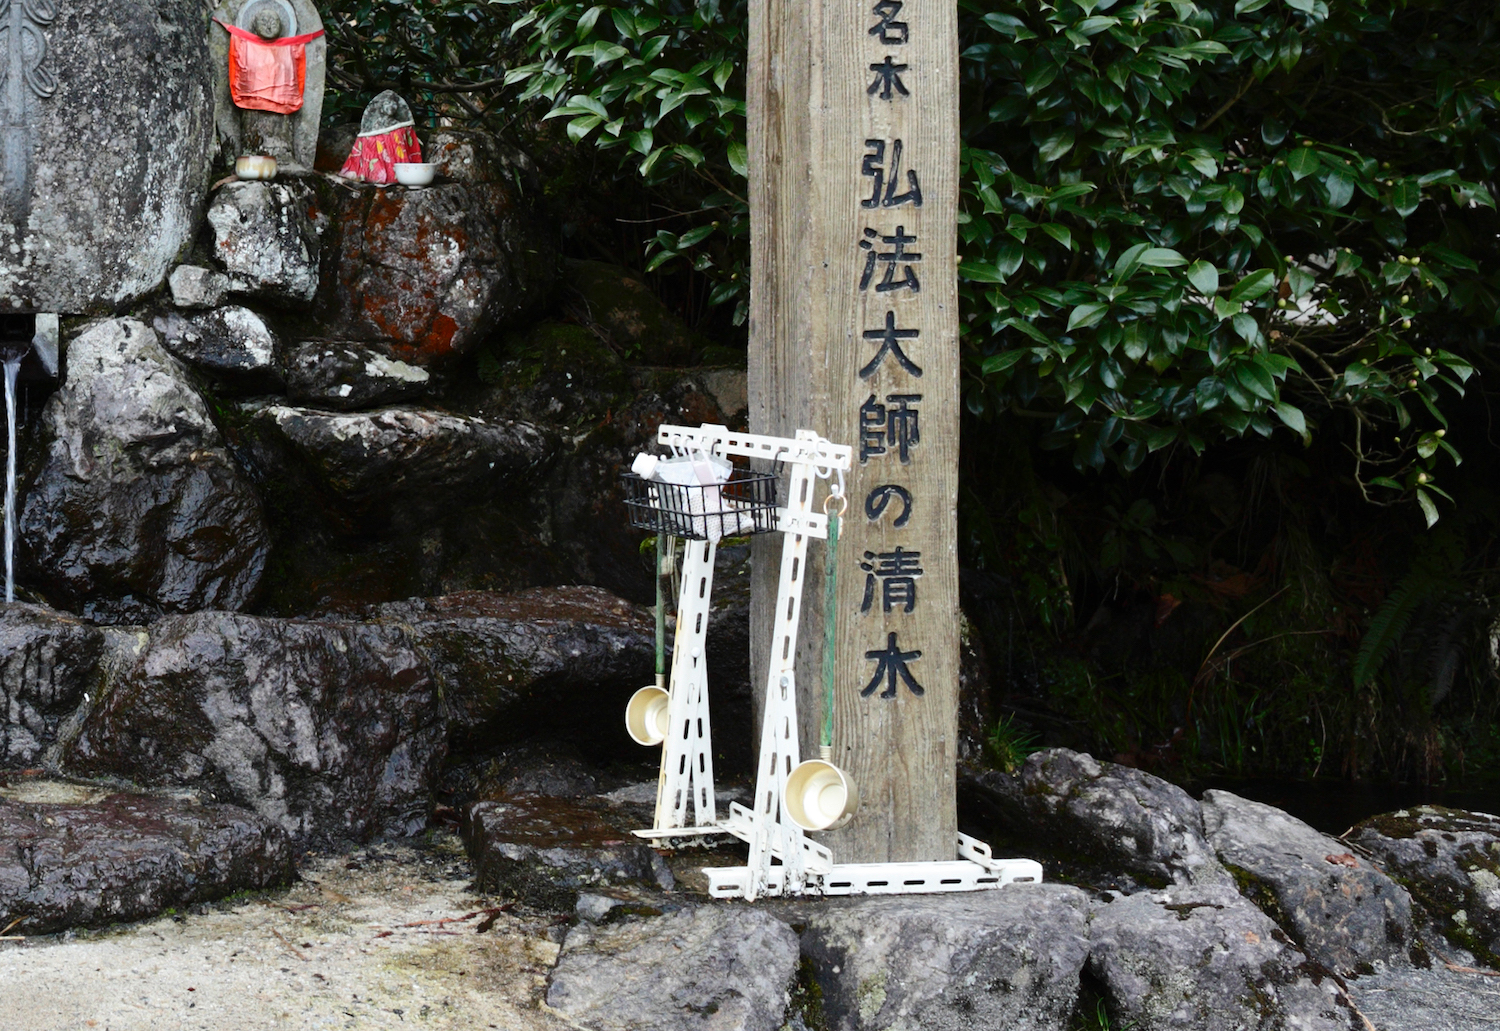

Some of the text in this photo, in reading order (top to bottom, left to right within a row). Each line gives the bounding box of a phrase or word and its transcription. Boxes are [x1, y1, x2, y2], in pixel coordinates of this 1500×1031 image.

[859, 138, 925, 700] 弘法大師の清水
